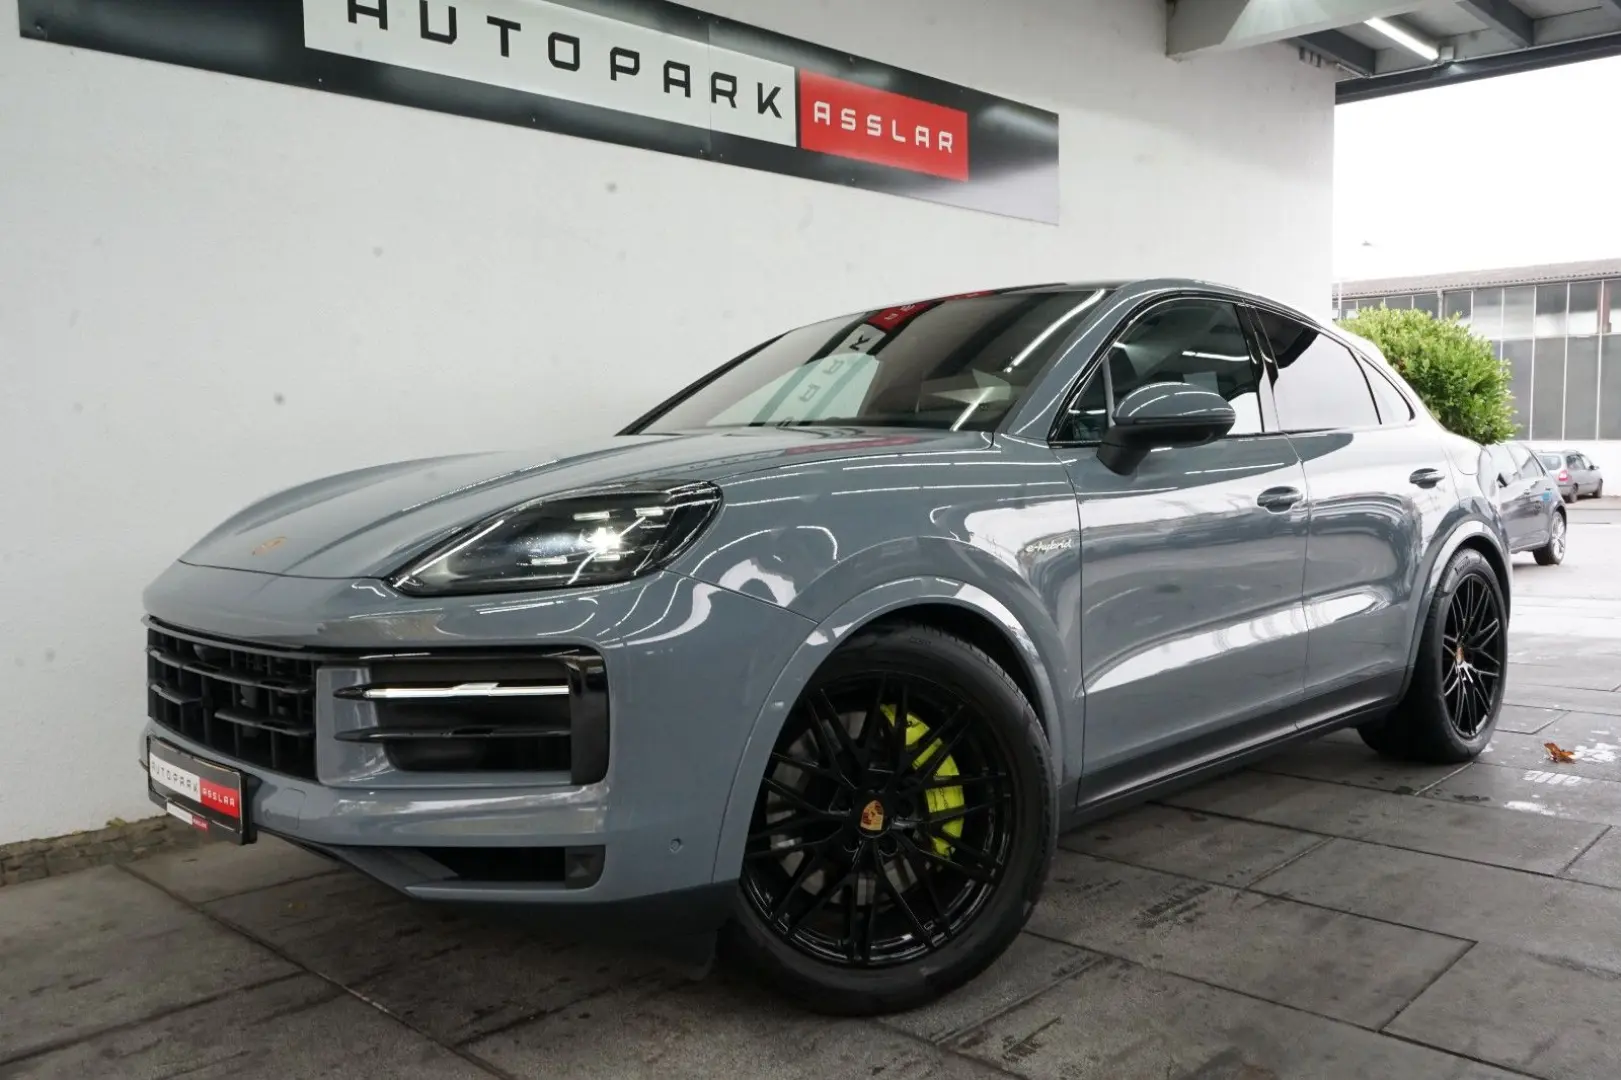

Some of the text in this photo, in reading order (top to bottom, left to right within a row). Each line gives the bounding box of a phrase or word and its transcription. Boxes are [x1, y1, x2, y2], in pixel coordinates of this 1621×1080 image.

[347, 0, 954, 155] AUTOPARK ASSLAR
[151, 761, 235, 807] AUTOPARK ASSLAR
